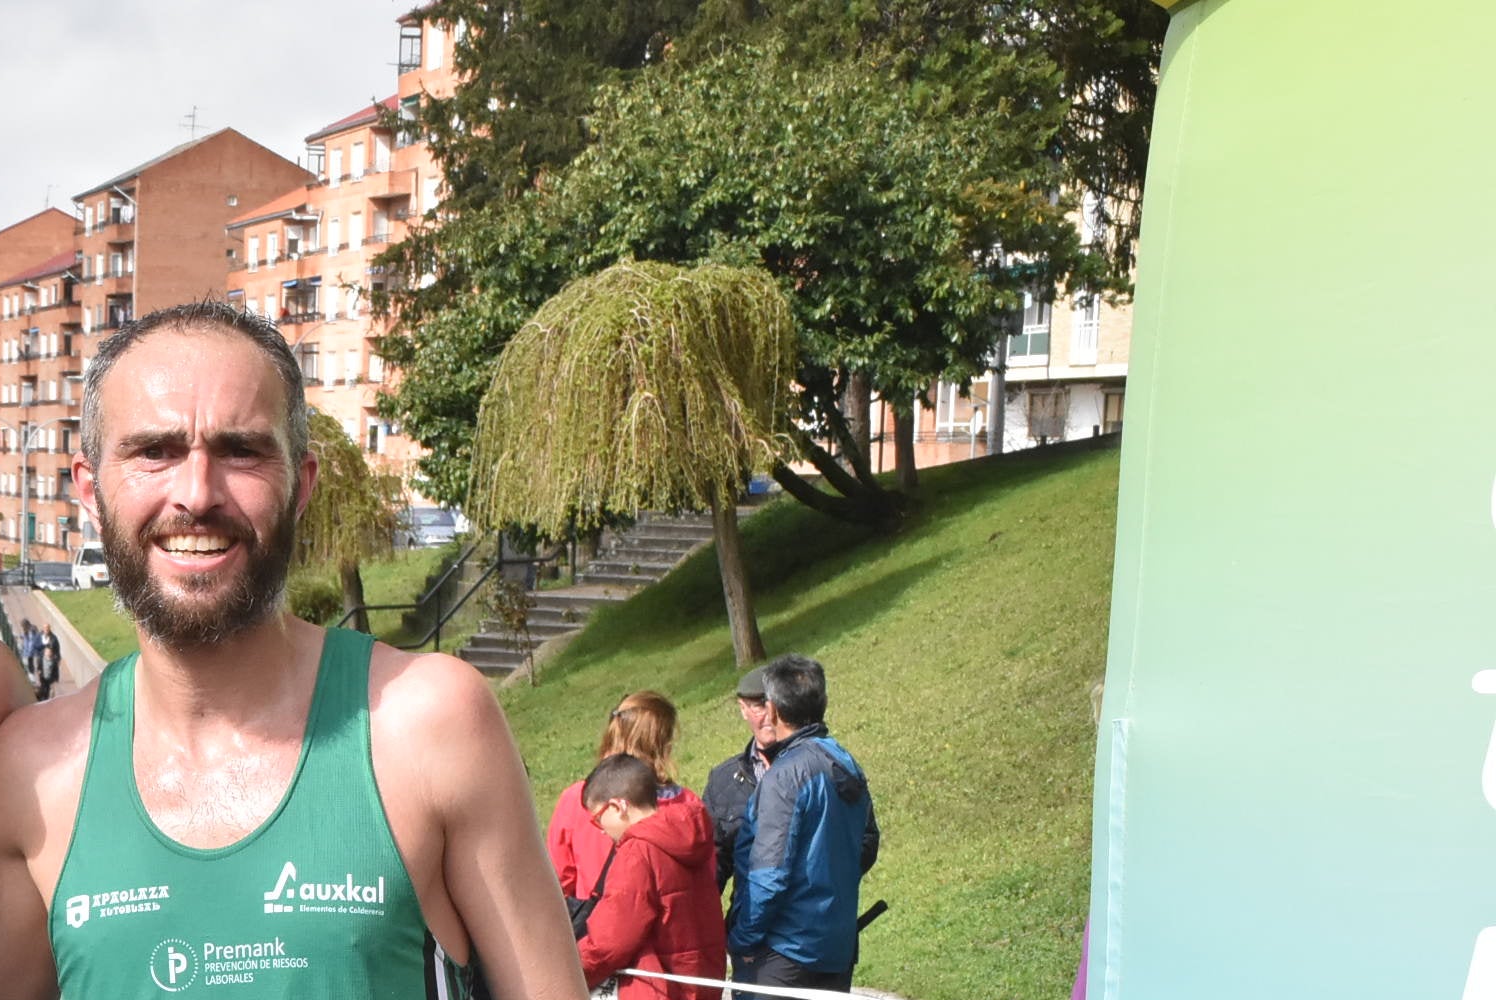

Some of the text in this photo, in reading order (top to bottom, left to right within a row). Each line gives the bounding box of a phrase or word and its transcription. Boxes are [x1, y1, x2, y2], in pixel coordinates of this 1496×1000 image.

[91, 885, 171, 908] APAOLAZA
[299, 873, 385, 904] auxkal
[299, 904, 337, 913] Elementos
[338, 905, 348, 914] de
[203, 936, 287, 961] Premank
[204, 957, 309, 974] PREVENCIÓN DE RIESGOS
[205, 972, 254, 986] LABORALES
